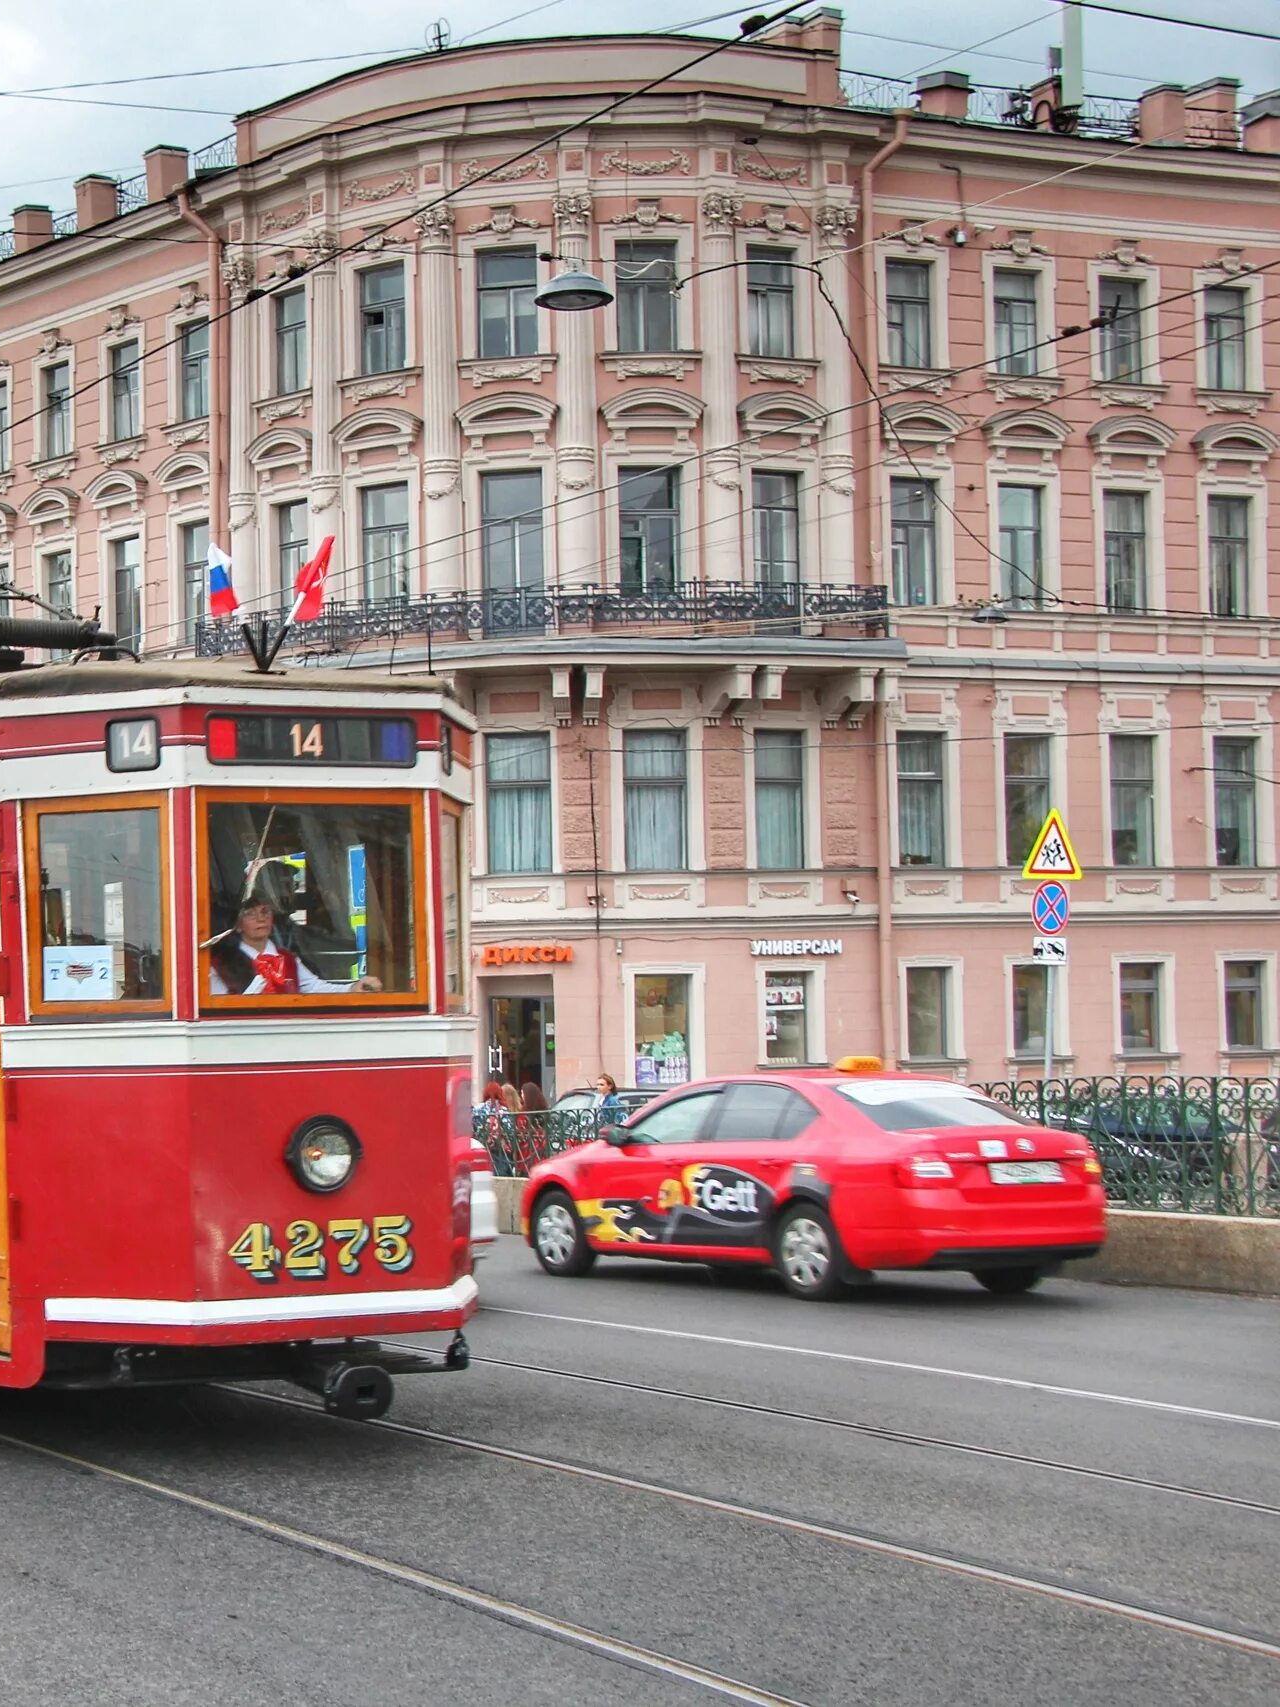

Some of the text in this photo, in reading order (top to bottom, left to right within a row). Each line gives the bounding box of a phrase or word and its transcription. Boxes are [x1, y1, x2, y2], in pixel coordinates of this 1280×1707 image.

[120, 722, 152, 758] 14
[289, 722, 324, 758] 14
[482, 945, 573, 968] ДИКСИ
[750, 939, 843, 956] УНИВЕРСАМ
[99, 966, 109, 980] 2
[701, 1178, 759, 1214] Gett
[227, 1215, 413, 1281] 4275
